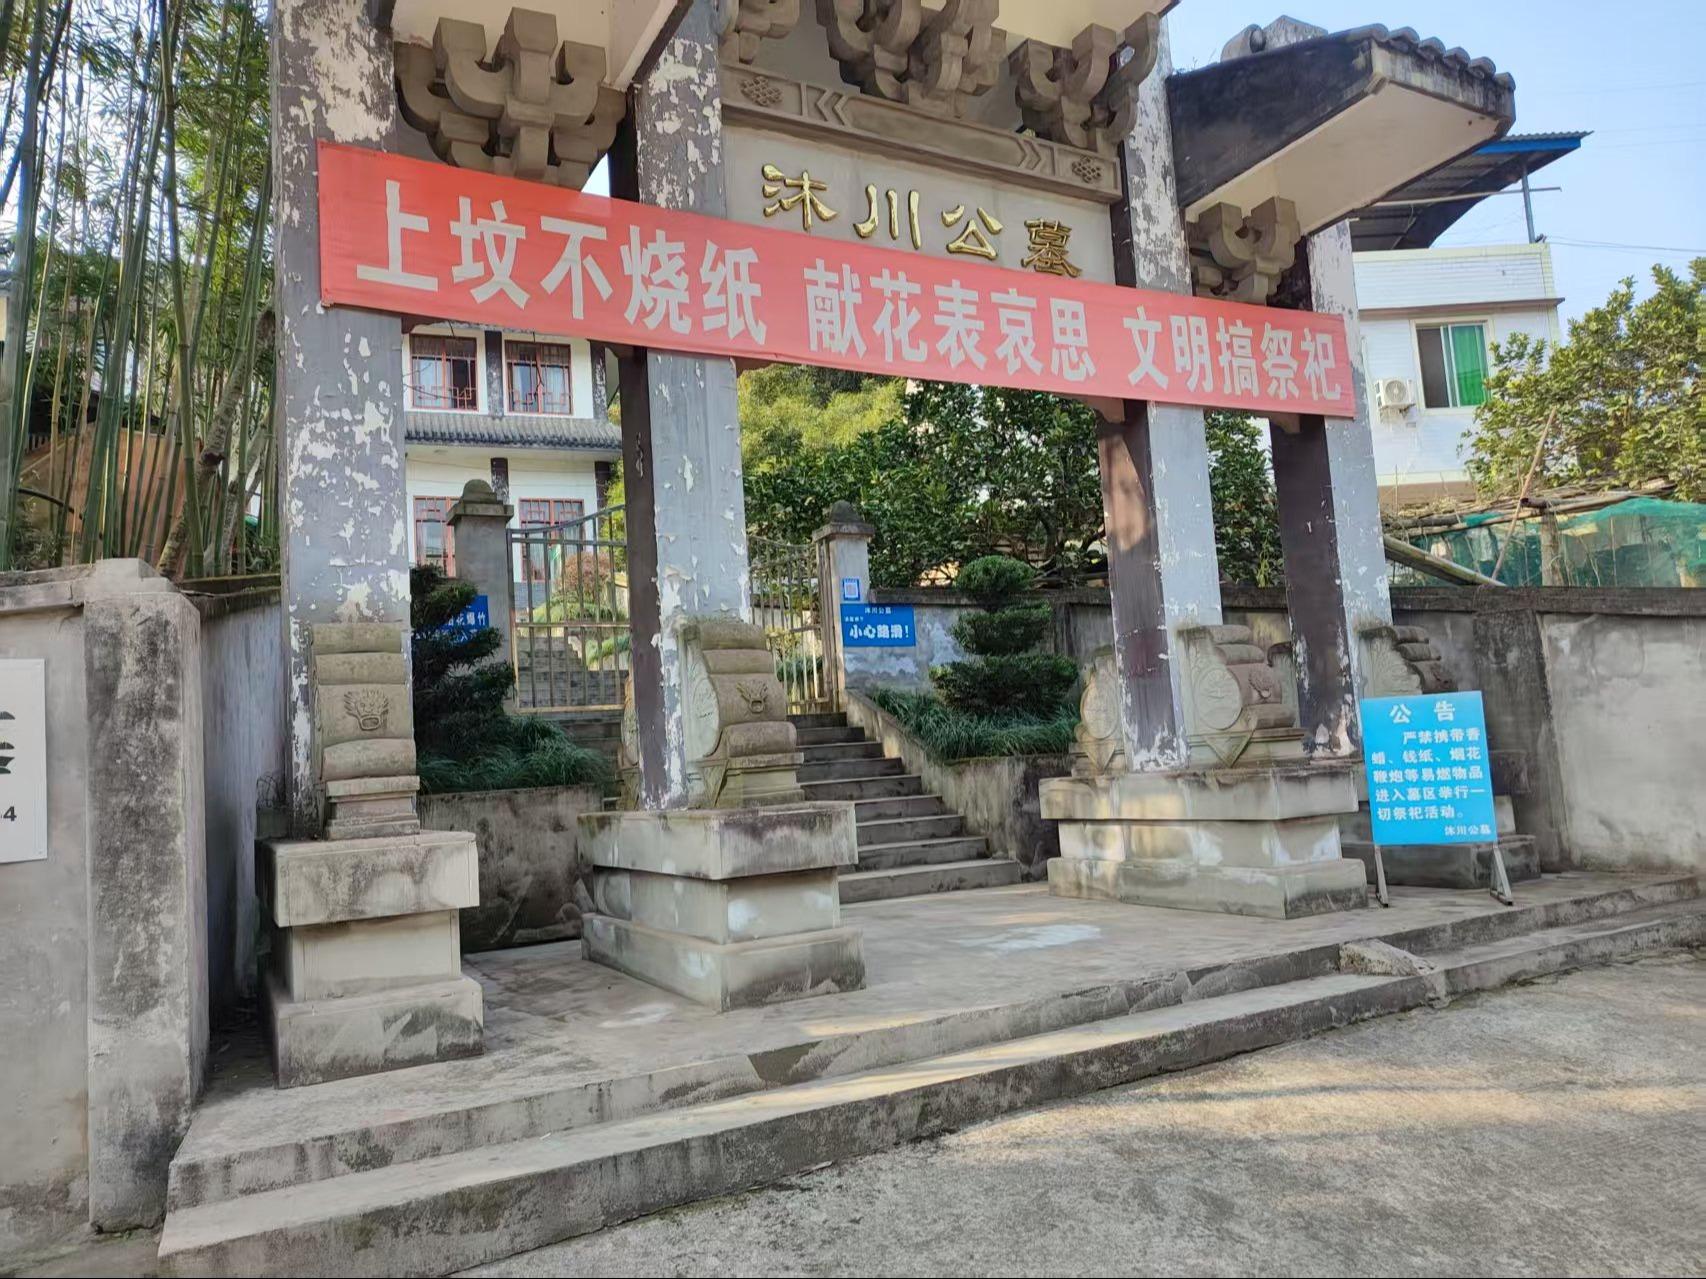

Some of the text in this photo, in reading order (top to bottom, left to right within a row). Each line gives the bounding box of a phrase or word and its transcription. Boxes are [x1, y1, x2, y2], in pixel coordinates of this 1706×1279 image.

[762, 163, 1082, 278] 沐川公墓
[356, 179, 1341, 401] 上坟不烧纸 献花表哀思 文明搞祭祀
[1389, 700, 1456, 724] 公告
[1402, 727, 1481, 745] 严禁携带香
[1373, 765, 1484, 784] 鞭炮等易燃物品
[1375, 785, 1486, 803] 进入墓区举行一
[1444, 823, 1491, 837] 沐川公墓
